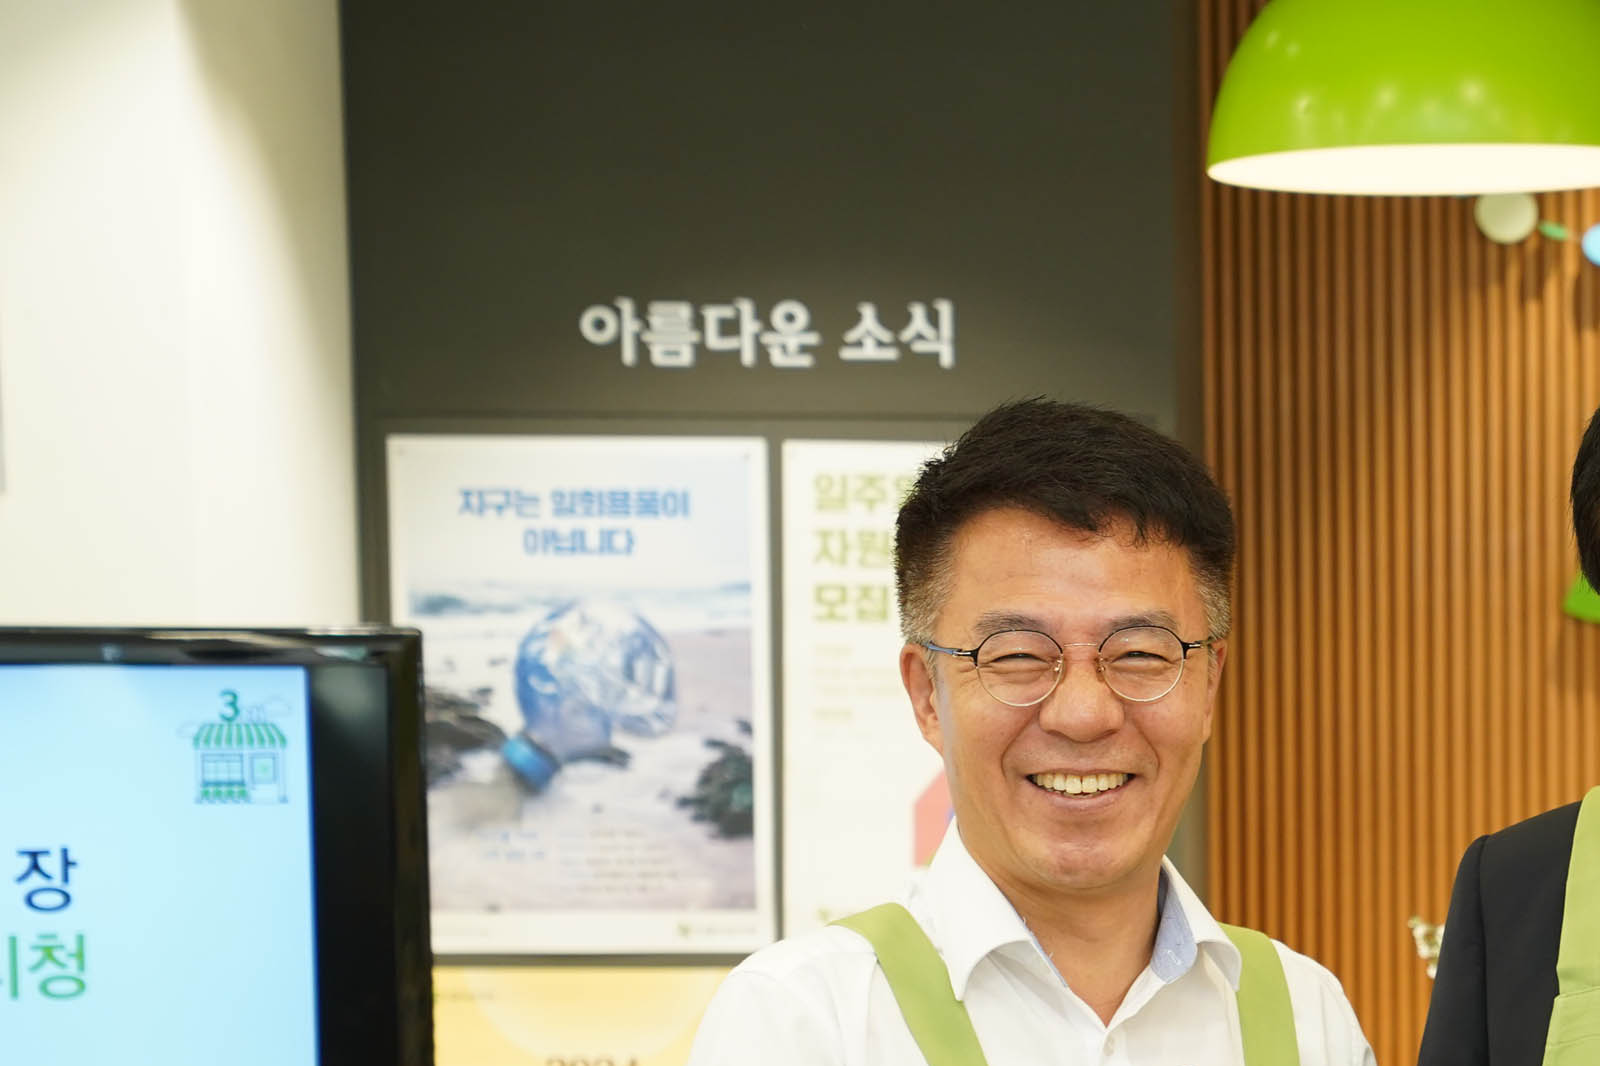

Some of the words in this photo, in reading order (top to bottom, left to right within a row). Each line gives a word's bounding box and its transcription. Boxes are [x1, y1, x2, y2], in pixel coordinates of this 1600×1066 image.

[579, 297, 821, 368] 아름다운
[838, 298, 956, 369] 소식
[458, 488, 540, 519] 지구는
[551, 488, 690, 519] 일회용품이
[523, 527, 635, 557] 아닙니다
[813, 584, 889, 623] 모집
[219, 690, 241, 722] 3
[16, 846, 77, 911] 장
